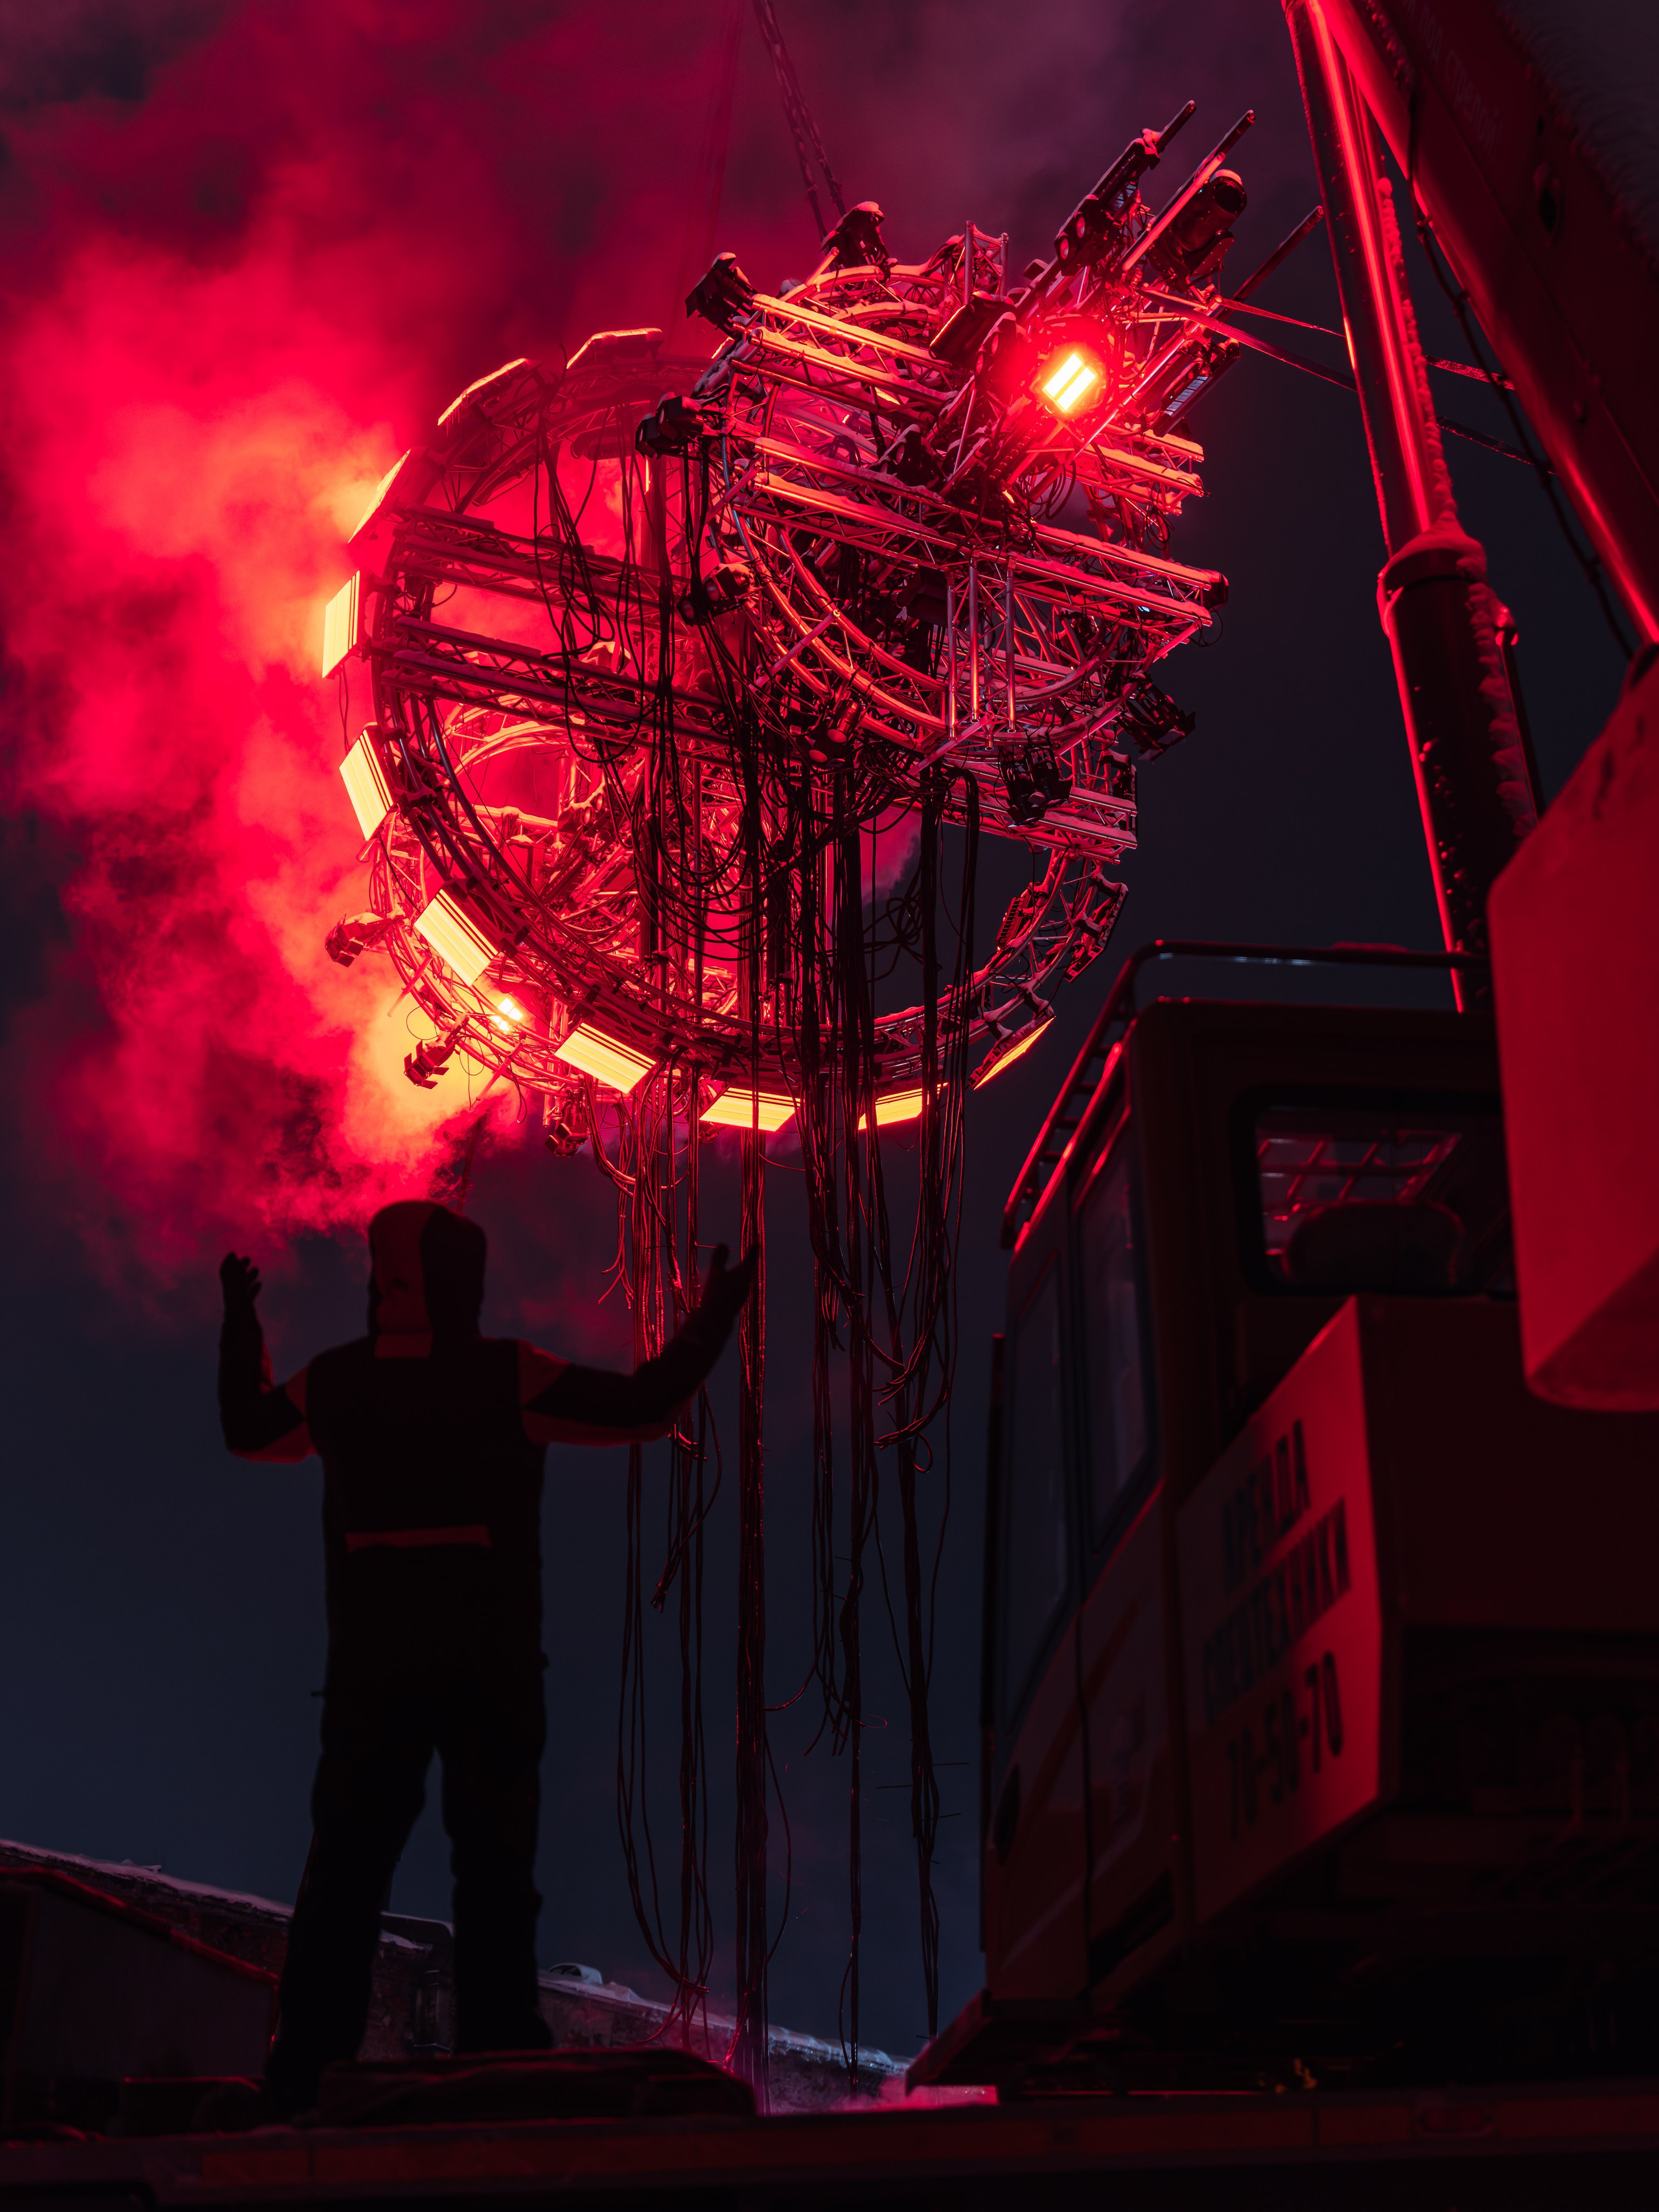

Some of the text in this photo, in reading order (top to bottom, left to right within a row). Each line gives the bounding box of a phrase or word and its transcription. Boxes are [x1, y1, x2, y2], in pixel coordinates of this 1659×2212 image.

[1222, 1416, 1310, 1593] АРЕНДА
[1203, 1495, 1352, 1722] СПЕЦТЕХНИКИ
[1225, 1652, 1343, 1837] 70-50-70
